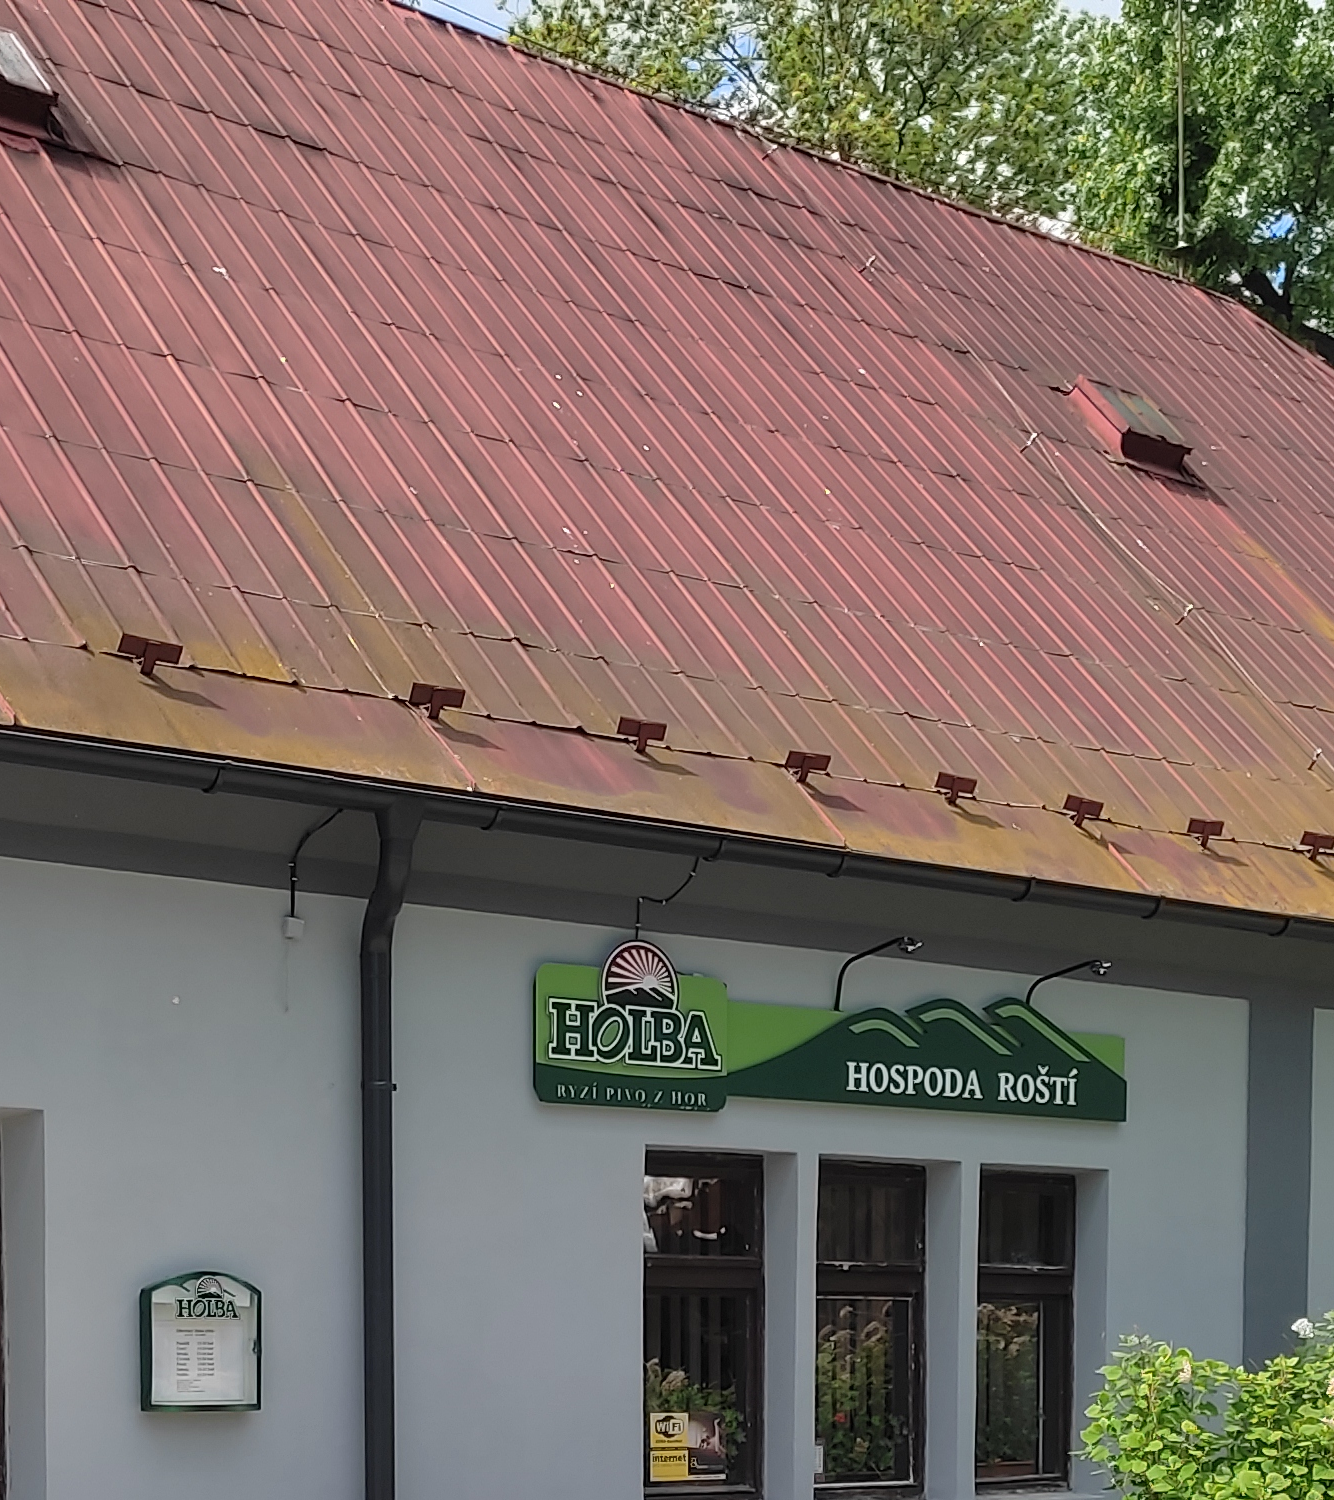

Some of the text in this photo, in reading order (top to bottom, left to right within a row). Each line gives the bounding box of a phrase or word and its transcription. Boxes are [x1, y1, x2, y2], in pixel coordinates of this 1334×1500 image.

[548, 997, 722, 1071] HOLBA
[557, 1082, 598, 1099] RYZÍ
[606, 1087, 646, 1103] PIVO
[671, 1091, 707, 1106] HOR
[846, 1061, 1079, 1106] HOSPODA ROŠTÍ
[175, 1298, 240, 1320] HOLBA
[652, 1454, 686, 1462] internet
